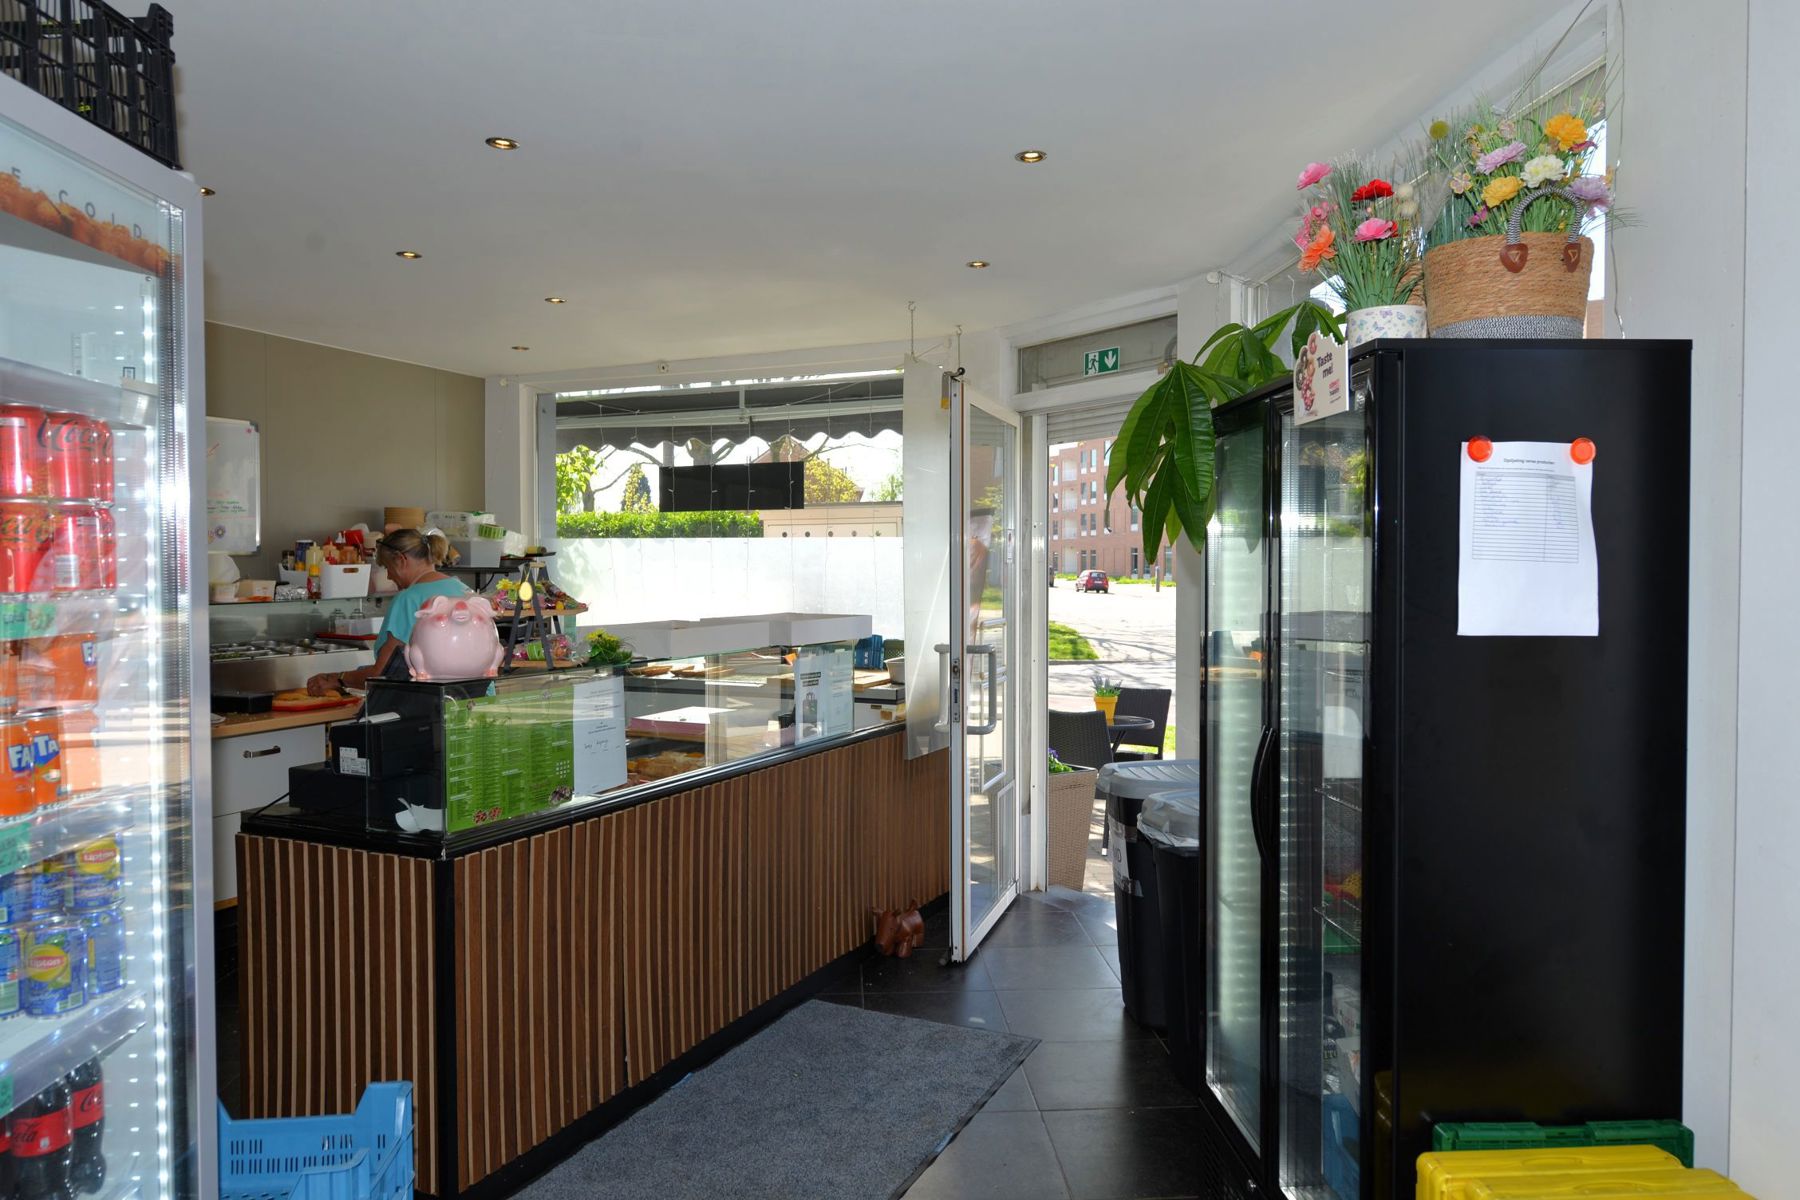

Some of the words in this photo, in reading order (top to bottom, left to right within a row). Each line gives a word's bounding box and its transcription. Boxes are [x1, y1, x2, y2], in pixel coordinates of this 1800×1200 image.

[1317, 352, 1333, 368] Taste
[1322, 363, 1334, 379] me!
[83, 849, 115, 862] Lipton
